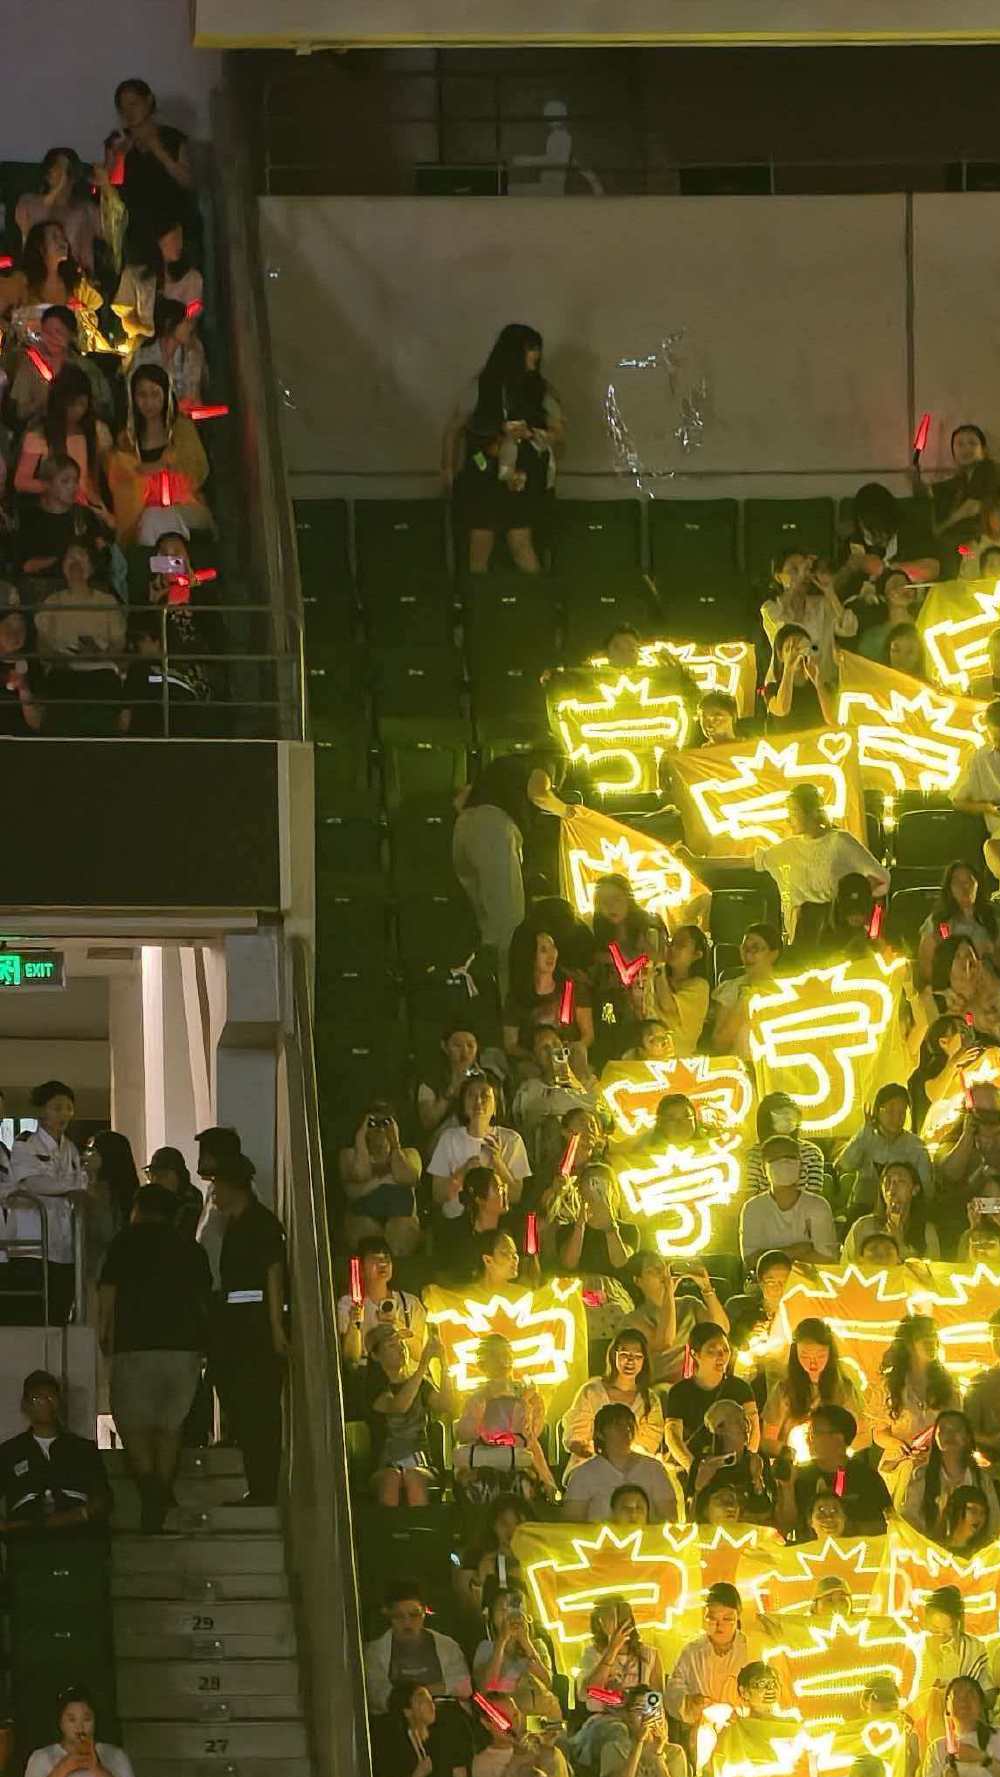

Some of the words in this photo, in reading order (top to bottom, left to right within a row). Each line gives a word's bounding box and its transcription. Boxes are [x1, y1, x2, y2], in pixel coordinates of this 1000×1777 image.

[24, 962, 54, 978] EXIT
[192, 1616, 214, 1631] 29
[204, 1739, 229, 1754] 27
